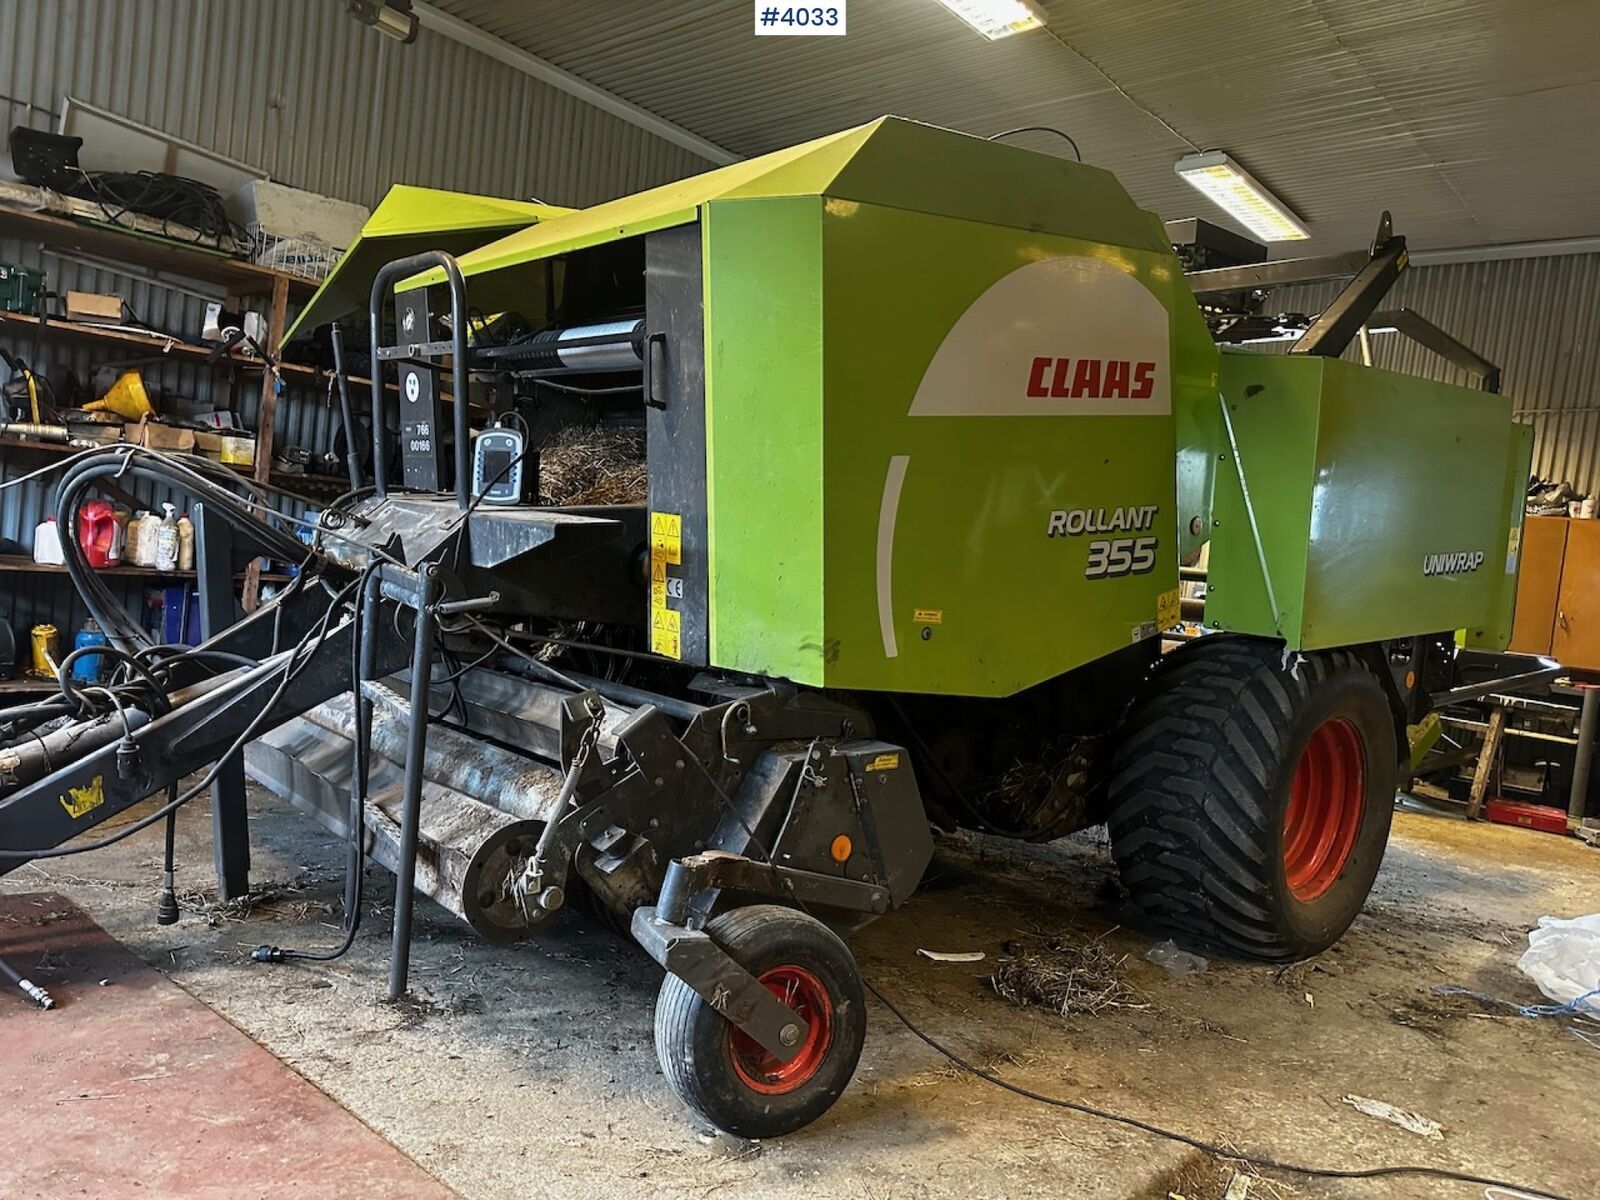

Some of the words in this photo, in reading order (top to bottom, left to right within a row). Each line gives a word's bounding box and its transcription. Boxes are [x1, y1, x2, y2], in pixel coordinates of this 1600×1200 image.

[1027, 357, 1156, 398] CLAAS
[1047, 505, 1158, 536] ROLLANT
[1085, 537, 1158, 580] 355
[1423, 551, 1485, 576] UNIWRAP
